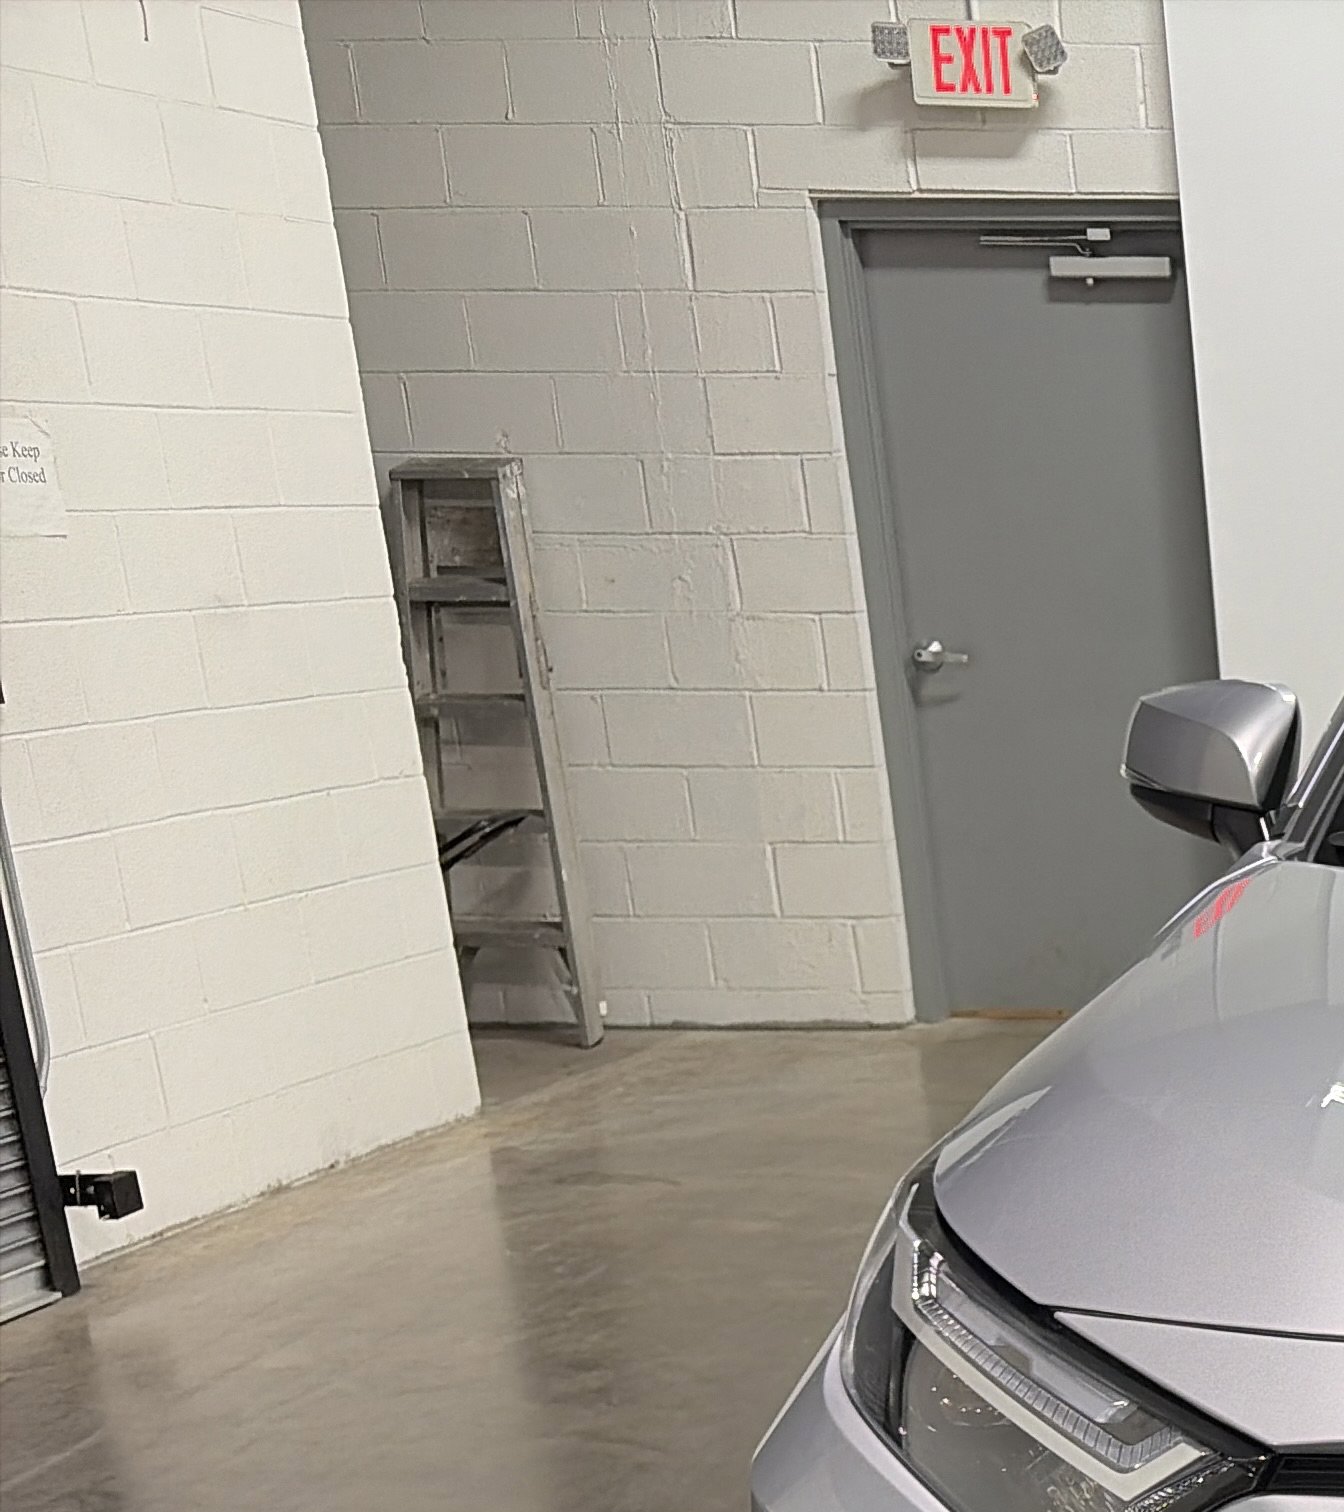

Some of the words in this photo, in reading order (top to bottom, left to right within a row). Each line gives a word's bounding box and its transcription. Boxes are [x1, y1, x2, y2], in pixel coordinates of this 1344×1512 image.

[929, 24, 1013, 96] EXIT
[10, 441, 41, 463] Keep
[8, 466, 46, 484] Closed
